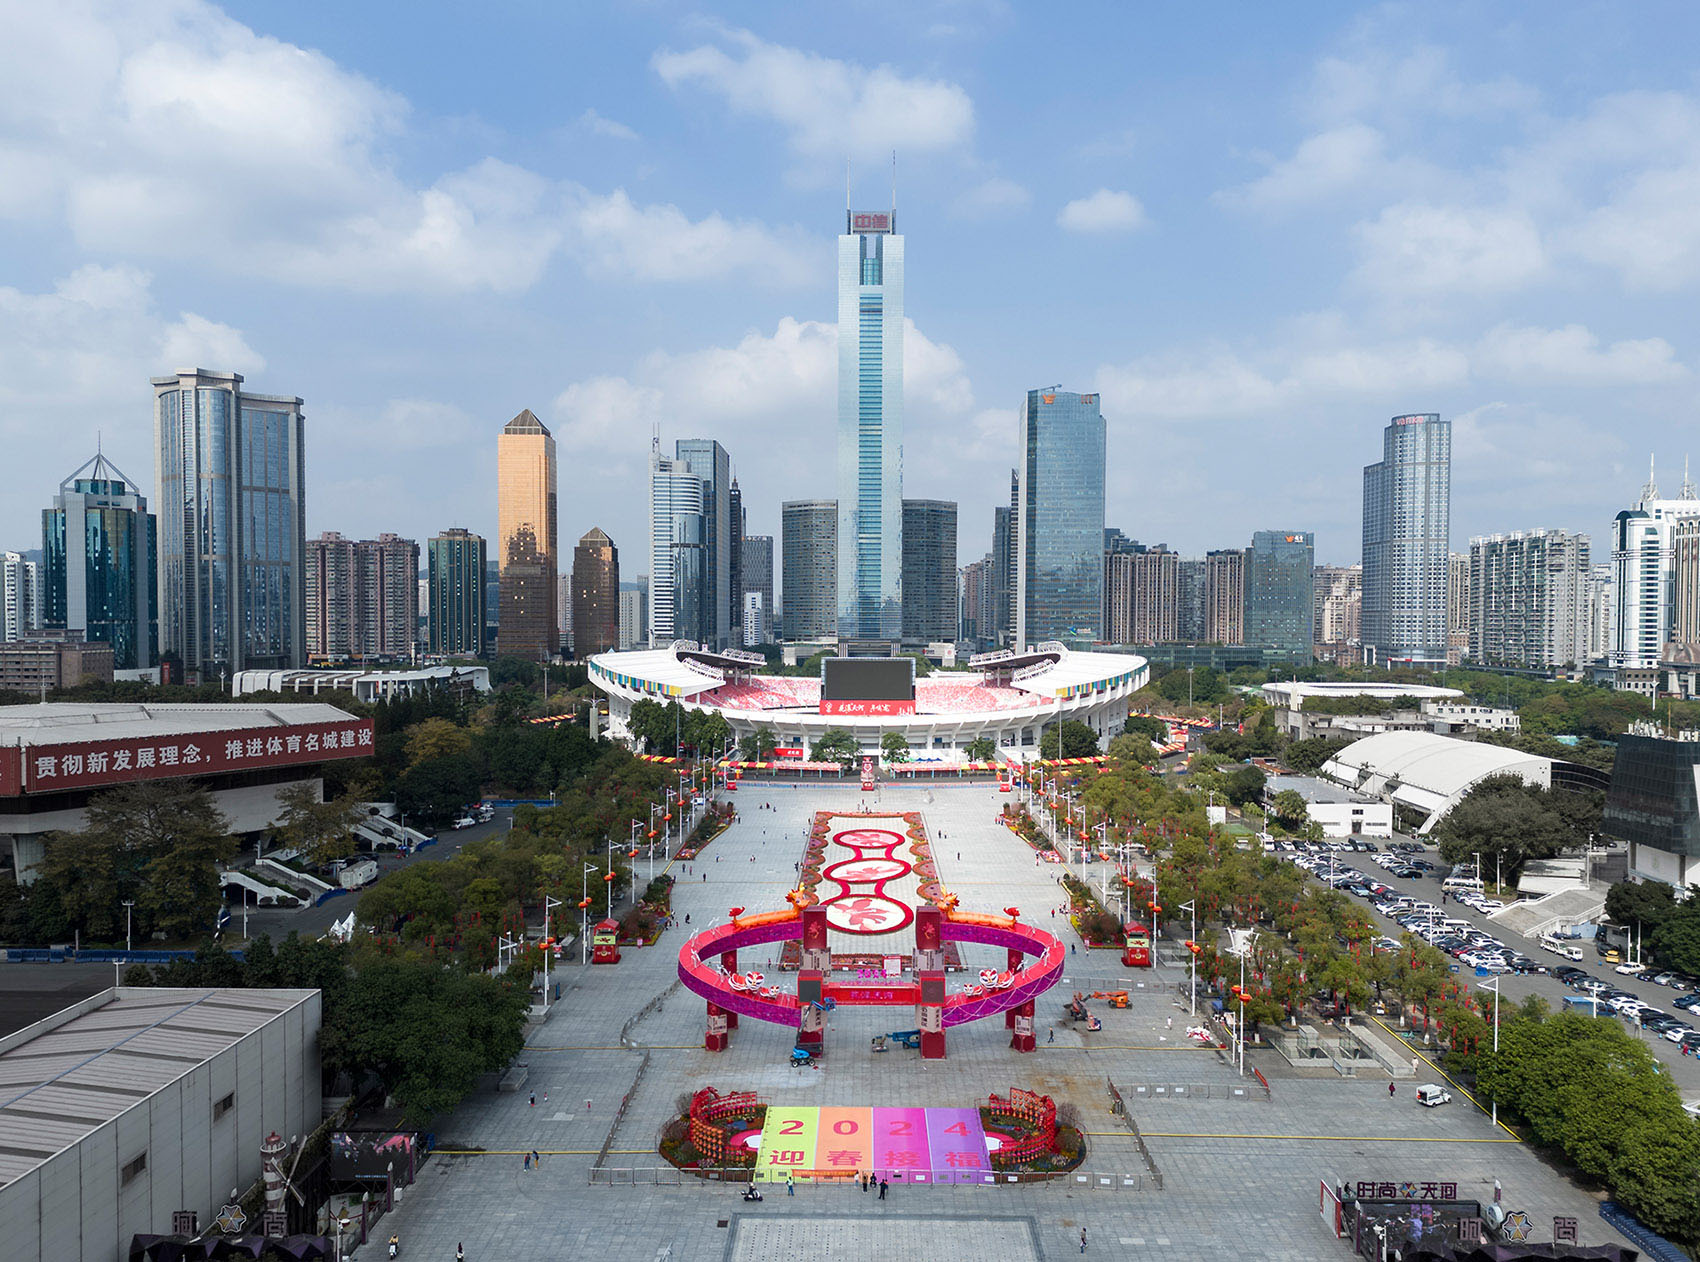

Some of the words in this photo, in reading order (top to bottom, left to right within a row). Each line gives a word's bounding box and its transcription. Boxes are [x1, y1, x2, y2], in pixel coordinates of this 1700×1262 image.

[855, 214, 888, 229] 中信
[35, 728, 373, 779] 贯彻新发展理念，推进体育名城建设
[1356, 1182, 1397, 1199] 时尚
[1420, 1182, 1458, 1199] 天河
